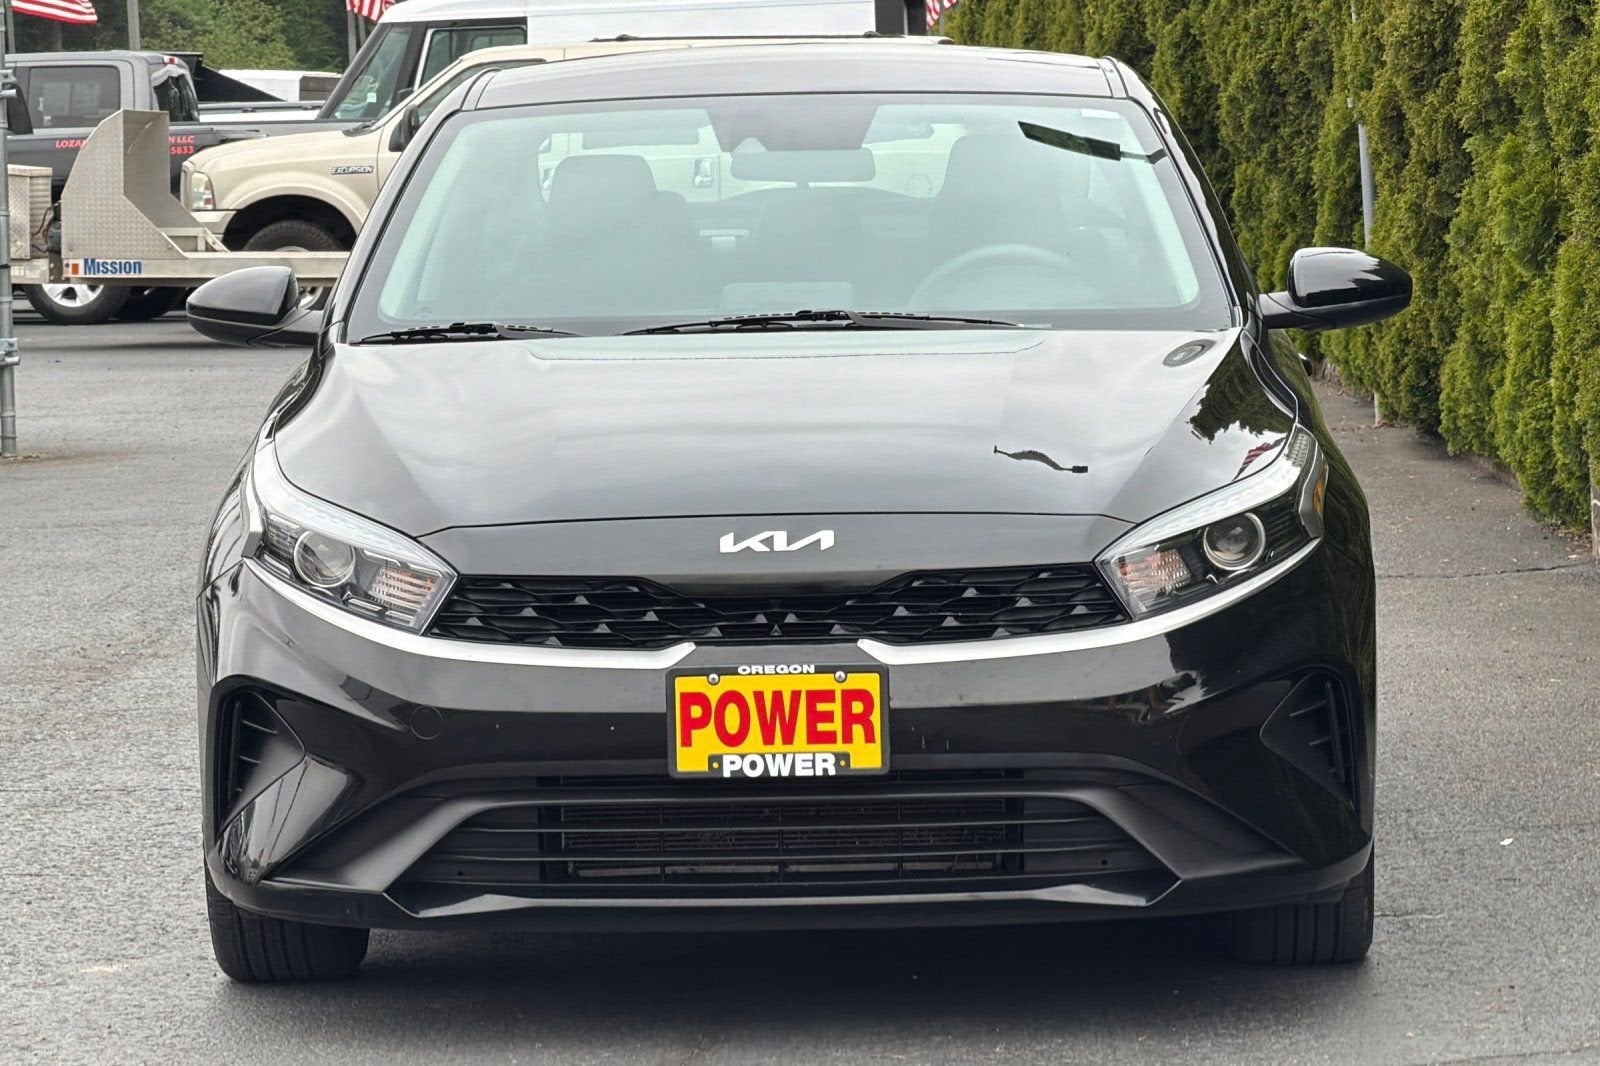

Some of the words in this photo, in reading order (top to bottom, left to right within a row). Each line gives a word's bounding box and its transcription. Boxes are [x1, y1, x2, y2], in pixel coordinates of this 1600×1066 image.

[177, 135, 195, 144] LLC
[330, 165, 374, 175] EXCURSION
[720, 530, 834, 553] KIA
[738, 664, 815, 675] OREGON
[679, 688, 876, 748] POWER
[722, 752, 837, 778] POWER
